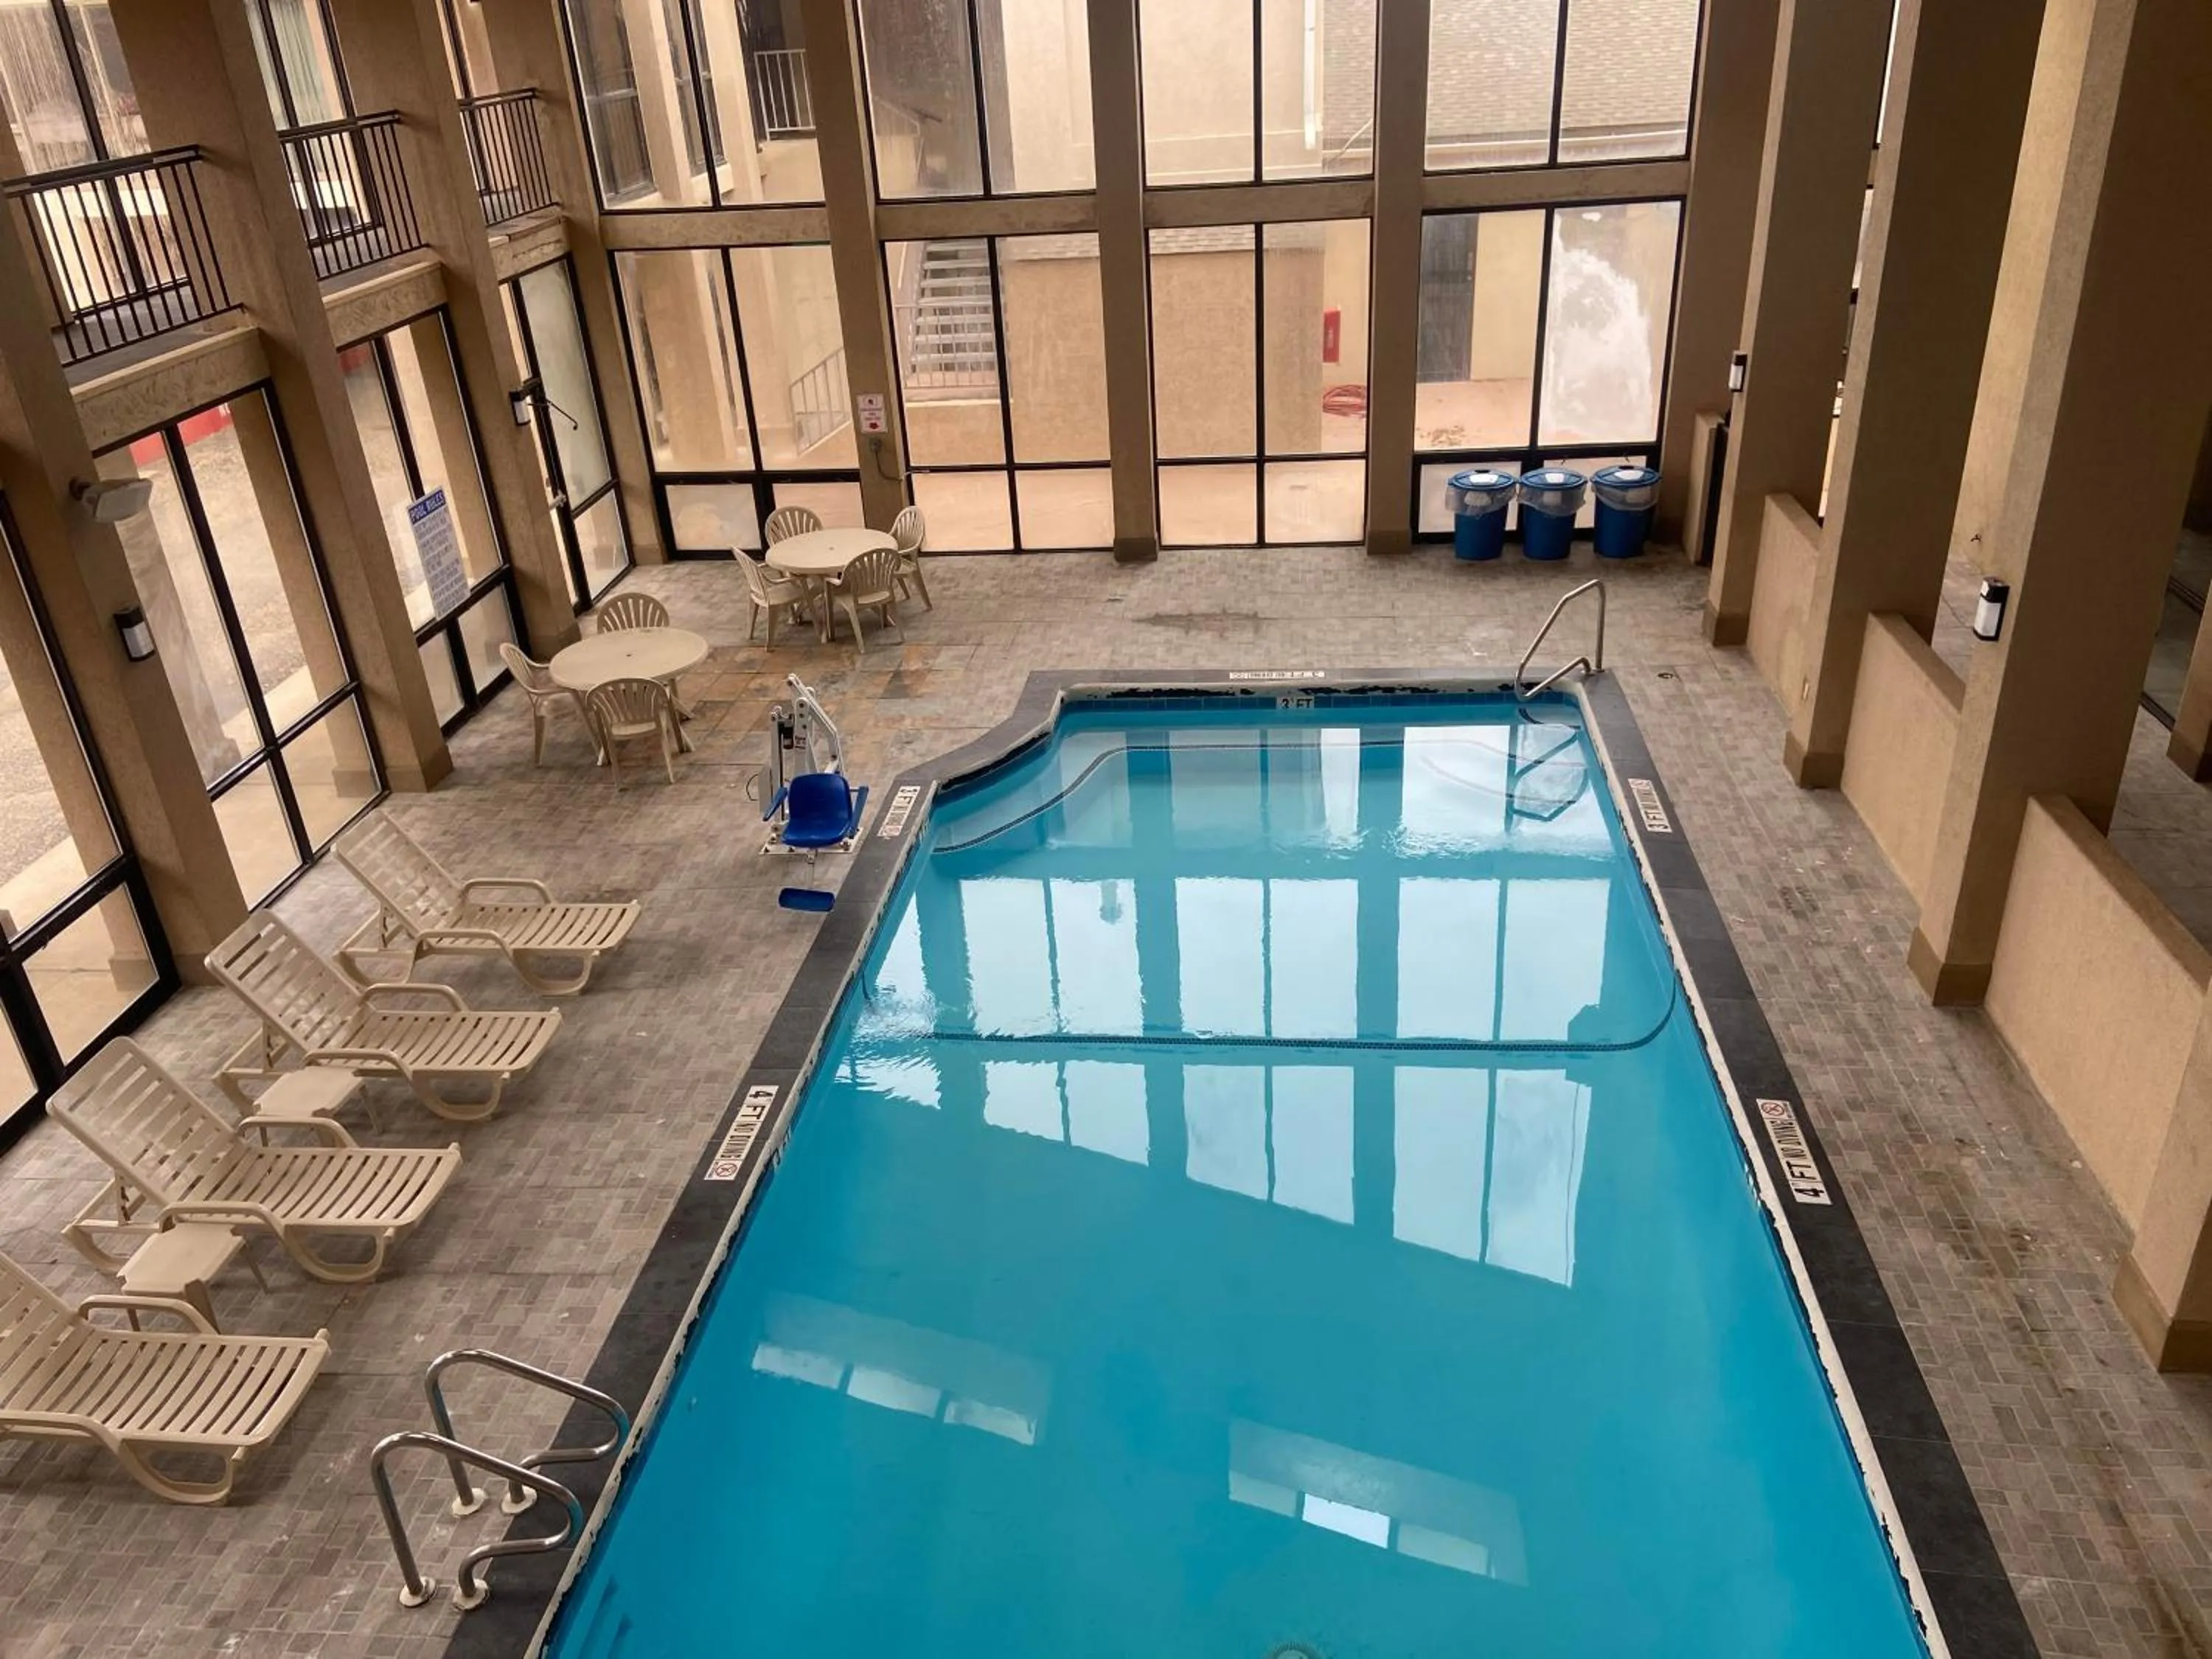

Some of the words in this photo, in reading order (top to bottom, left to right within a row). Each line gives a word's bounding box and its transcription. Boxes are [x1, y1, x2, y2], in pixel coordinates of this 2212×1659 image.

[741, 1105, 766, 1119] FT
[734, 1123, 757, 1133] NO
[1781, 1147, 1806, 1158] NO
[1786, 1161, 1817, 1180] FT
[1794, 1188, 1824, 1198] 4
